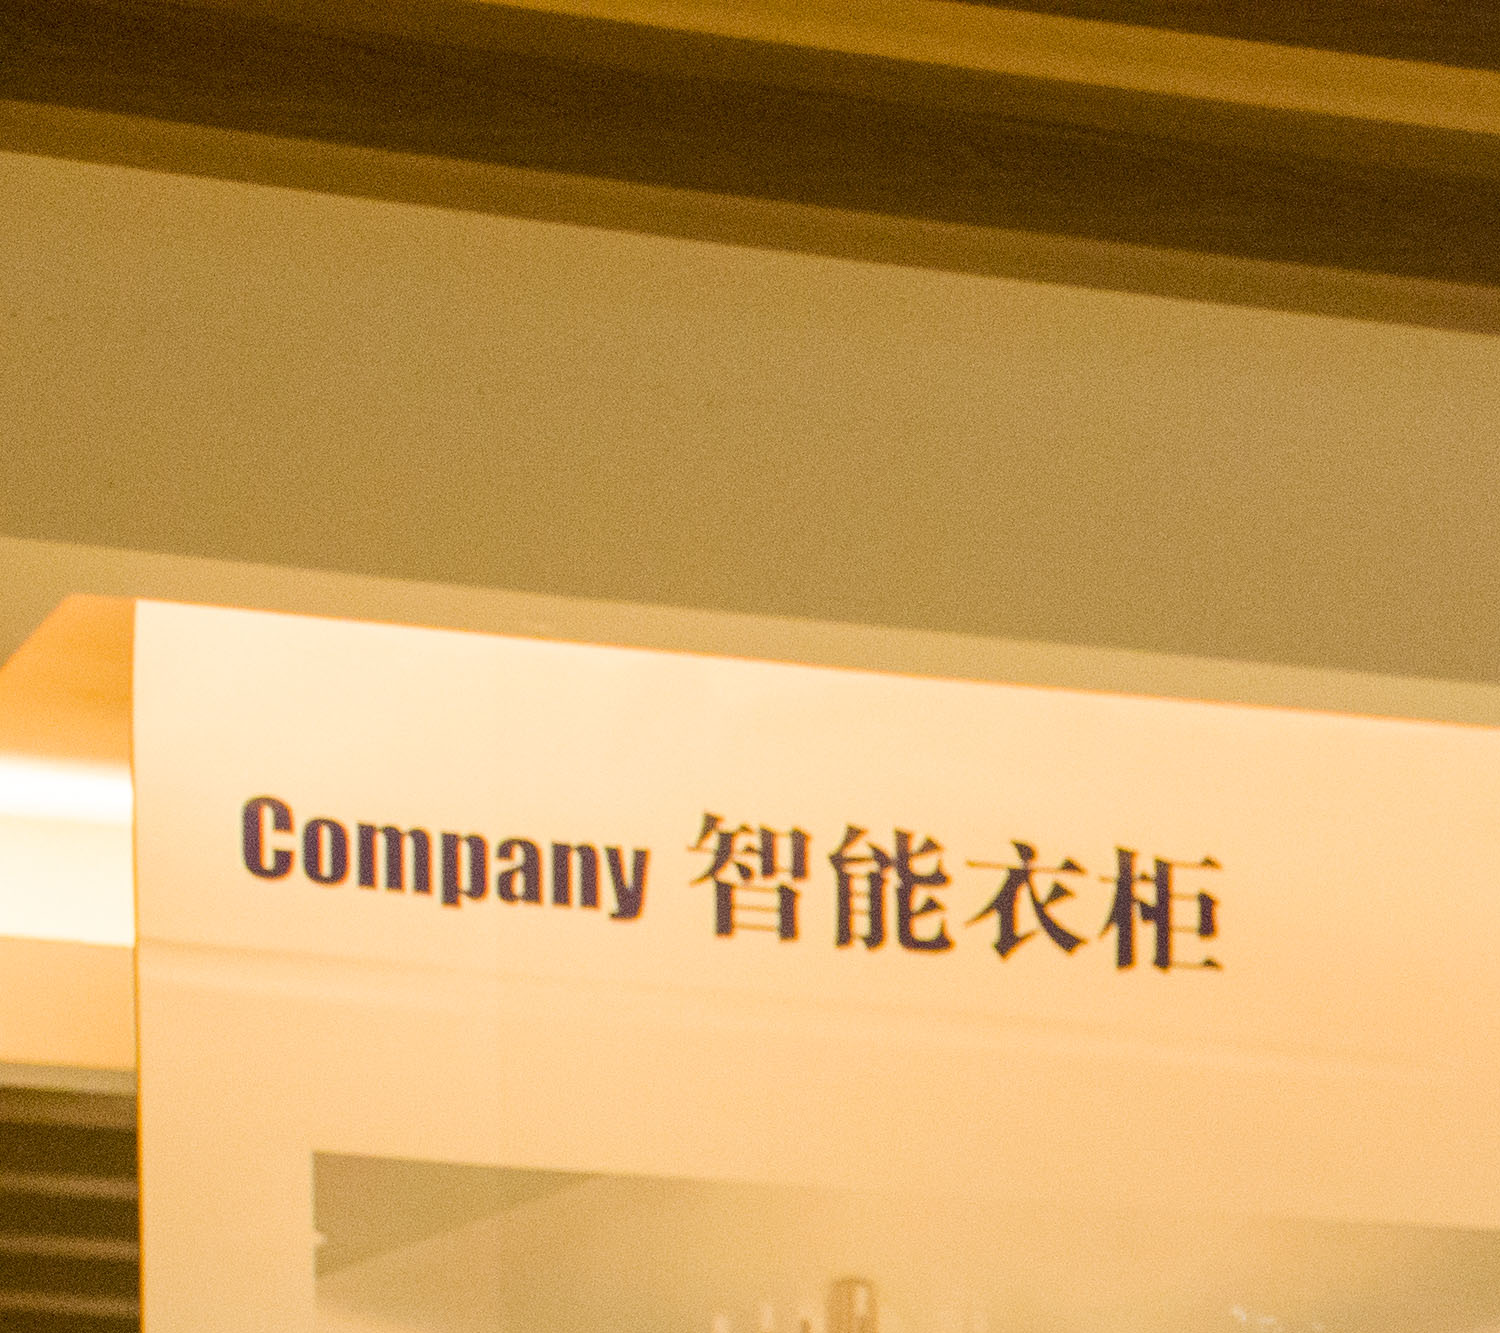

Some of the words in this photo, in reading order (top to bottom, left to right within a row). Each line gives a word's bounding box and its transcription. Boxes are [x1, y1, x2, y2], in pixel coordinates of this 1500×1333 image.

[239, 793, 652, 923] Company
[688, 811, 1224, 975] 智能衣柜
